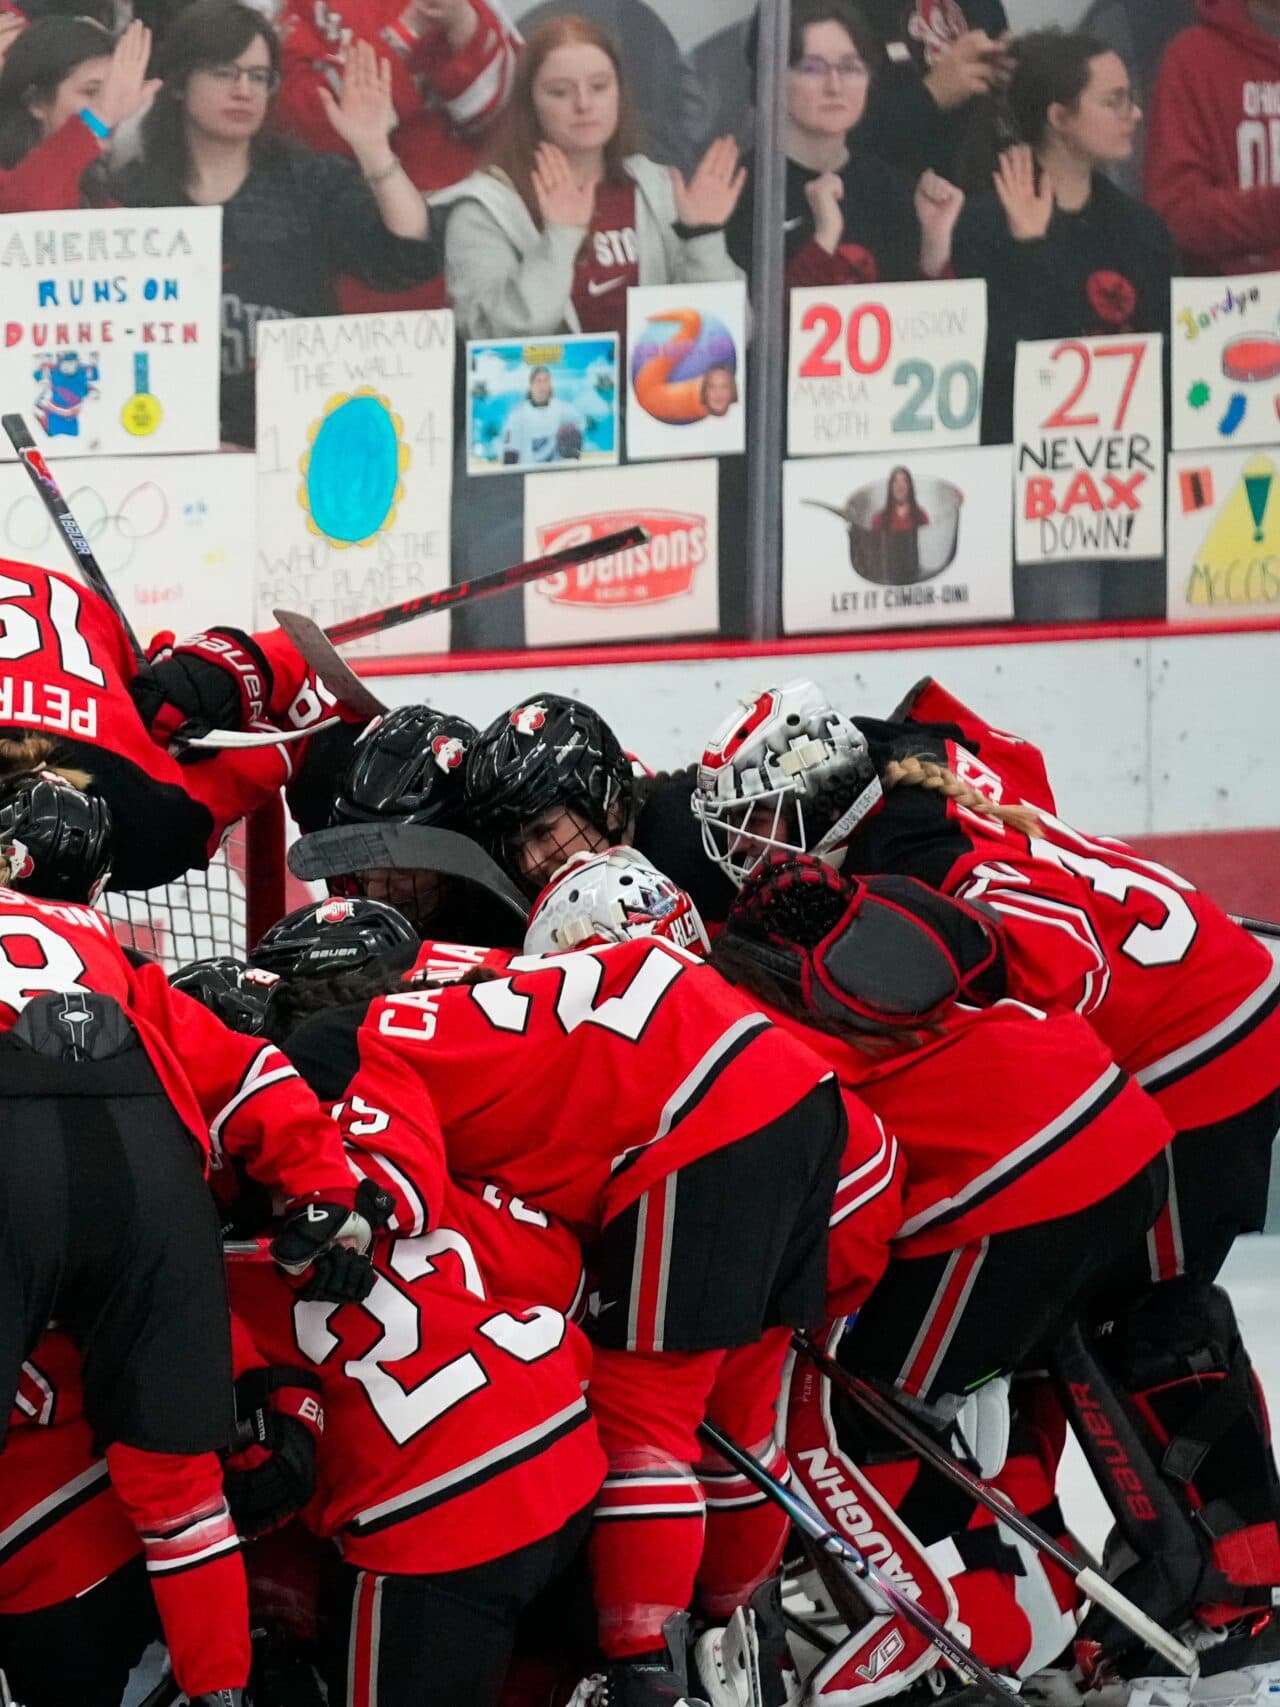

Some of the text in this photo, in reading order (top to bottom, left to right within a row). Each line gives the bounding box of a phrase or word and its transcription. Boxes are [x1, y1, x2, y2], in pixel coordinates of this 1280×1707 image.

[38, 275, 179, 307] RUNS ON
[800, 302, 892, 378] 20
[891, 356, 980, 432] 20
[1019, 434, 1155, 472] NEVER
[1025, 473, 1146, 520] BAX
[1040, 514, 1135, 554] DOWN!
[309, 948, 358, 960] BAUER
[1068, 1382, 1157, 1522] BAUER
[797, 1446, 923, 1604] VAUGHN
